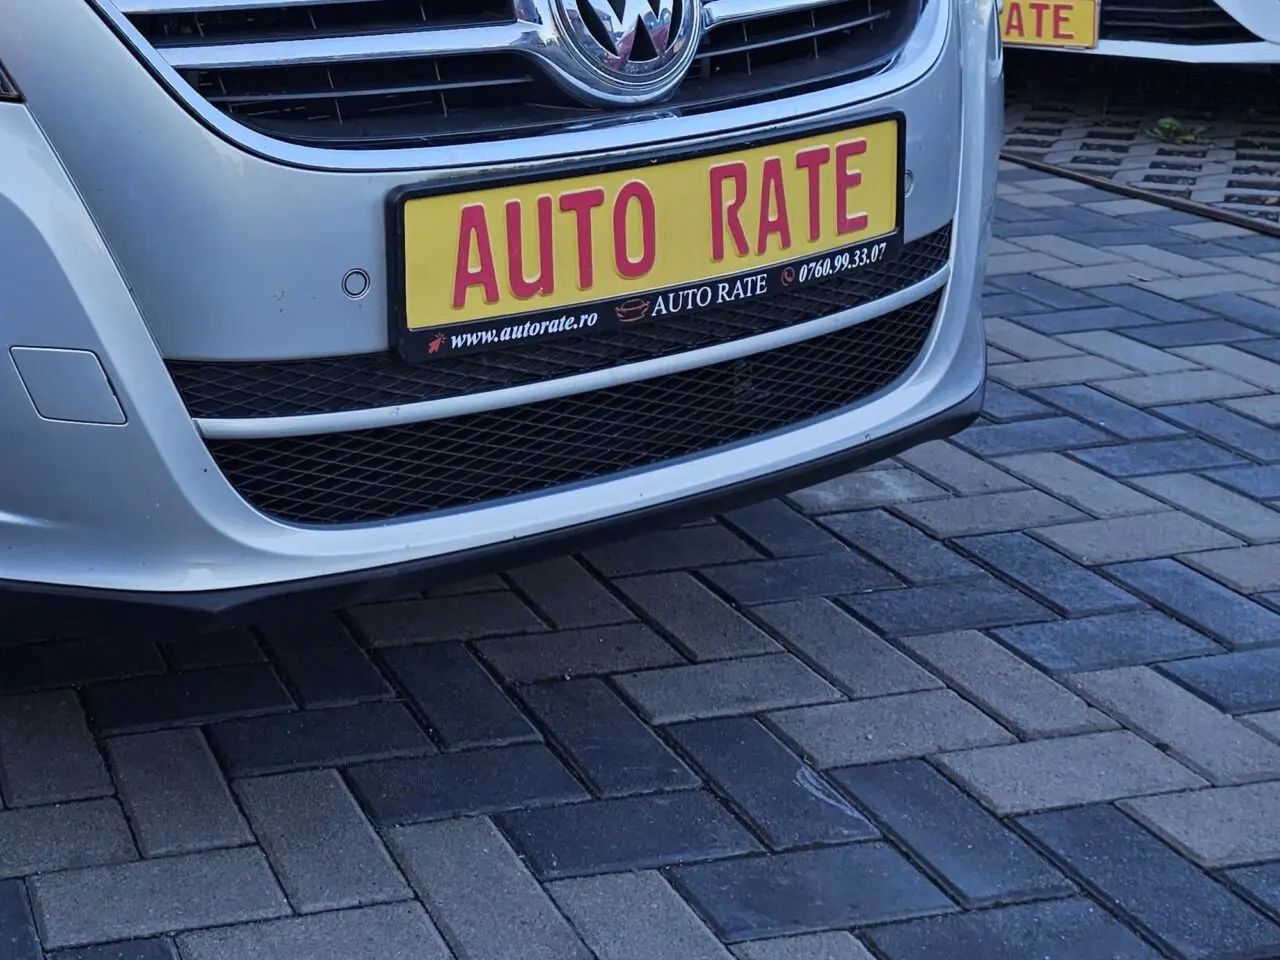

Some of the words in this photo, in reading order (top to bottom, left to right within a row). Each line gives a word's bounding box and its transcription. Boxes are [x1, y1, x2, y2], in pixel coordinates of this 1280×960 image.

[1004, 1, 1075, 39] ATE
[451, 179, 656, 310] AUTO
[708, 137, 869, 262] RATE
[450, 311, 599, 350] www.autorate.ro
[650, 285, 712, 317] AUTO
[716, 273, 768, 305] RATE
[798, 242, 888, 284] 0760.99.33.07
